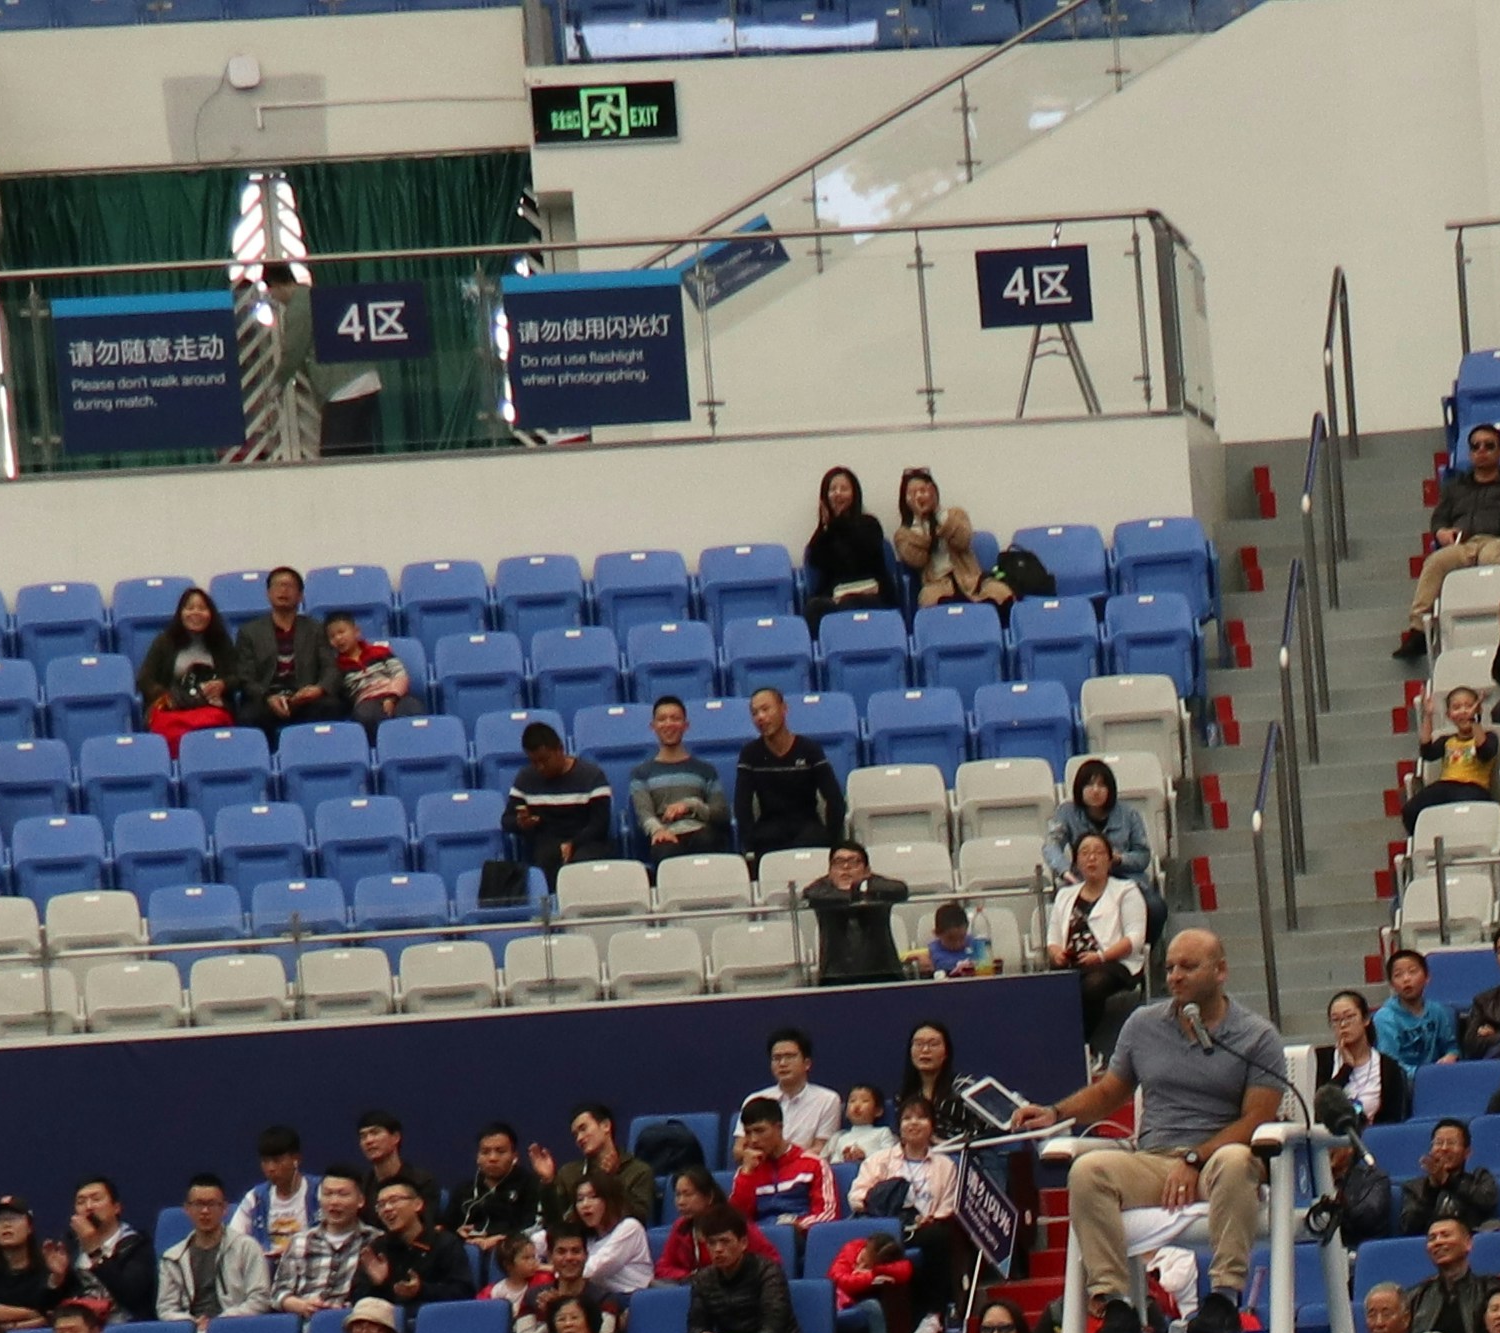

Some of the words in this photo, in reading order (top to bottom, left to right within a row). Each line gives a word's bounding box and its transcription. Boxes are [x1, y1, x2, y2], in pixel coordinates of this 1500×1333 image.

[629, 105, 659, 127] EXIT
[1002, 264, 1072, 305] 4区
[337, 301, 408, 343] 4区
[518, 313, 671, 344] 请勿使用闪光灯
[69, 335, 225, 367] 请勿随意走动
[520, 354, 539, 368] Do
[541, 351, 561, 367] not
[564, 353, 587, 364] use
[589, 348, 644, 366] flashlight
[71, 379, 115, 392] Please
[117, 376, 148, 389] don't
[151, 375, 178, 387] walk
[180, 373, 226, 386] around
[521, 374, 555, 386] when
[558, 368, 649, 387] photographing.
[73, 398, 113, 412] during
[115, 396, 158, 408] match.
